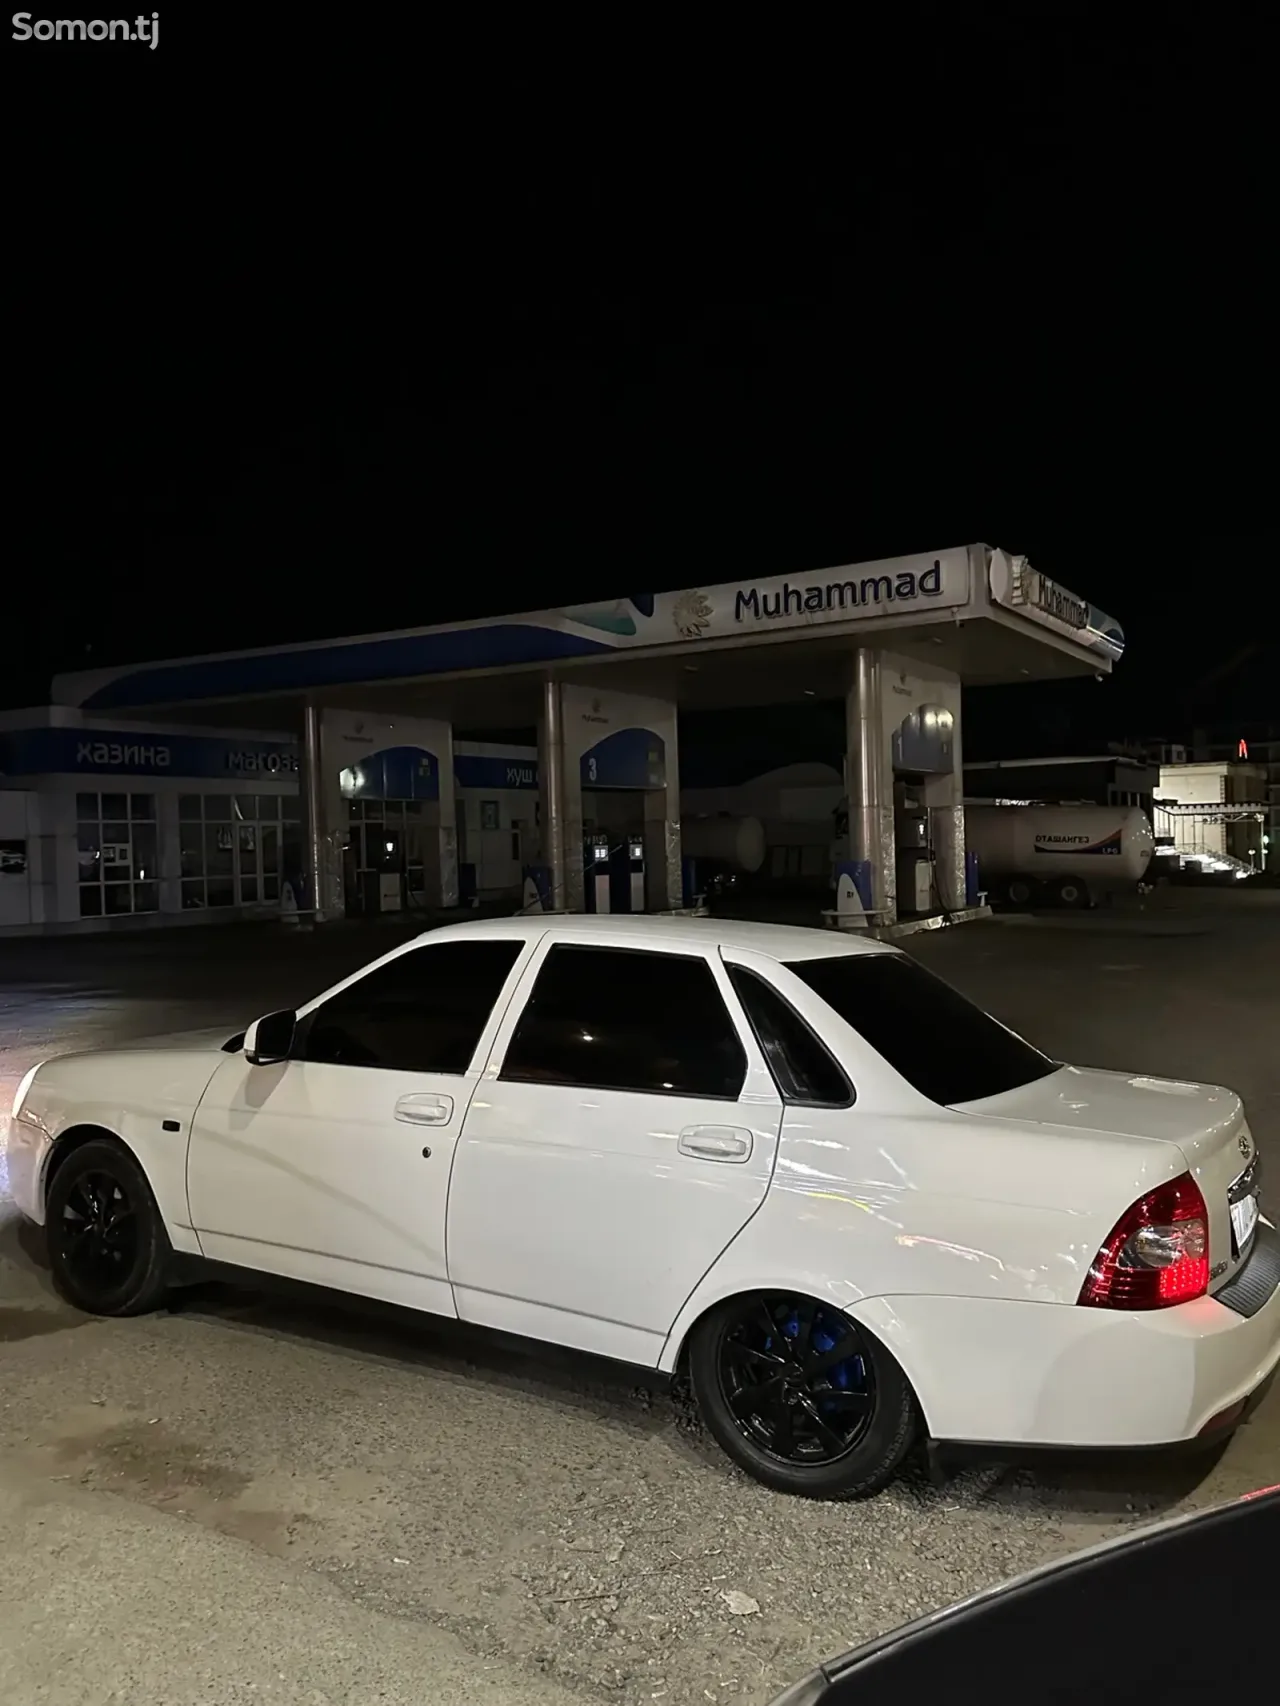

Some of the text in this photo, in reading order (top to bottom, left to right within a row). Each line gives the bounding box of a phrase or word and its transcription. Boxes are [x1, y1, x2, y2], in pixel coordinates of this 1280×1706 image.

[735, 559, 943, 620] Muhammad
[76, 741, 171, 767] хазина
[506, 767, 533, 787] хуш
[588, 757, 598, 781] 3
